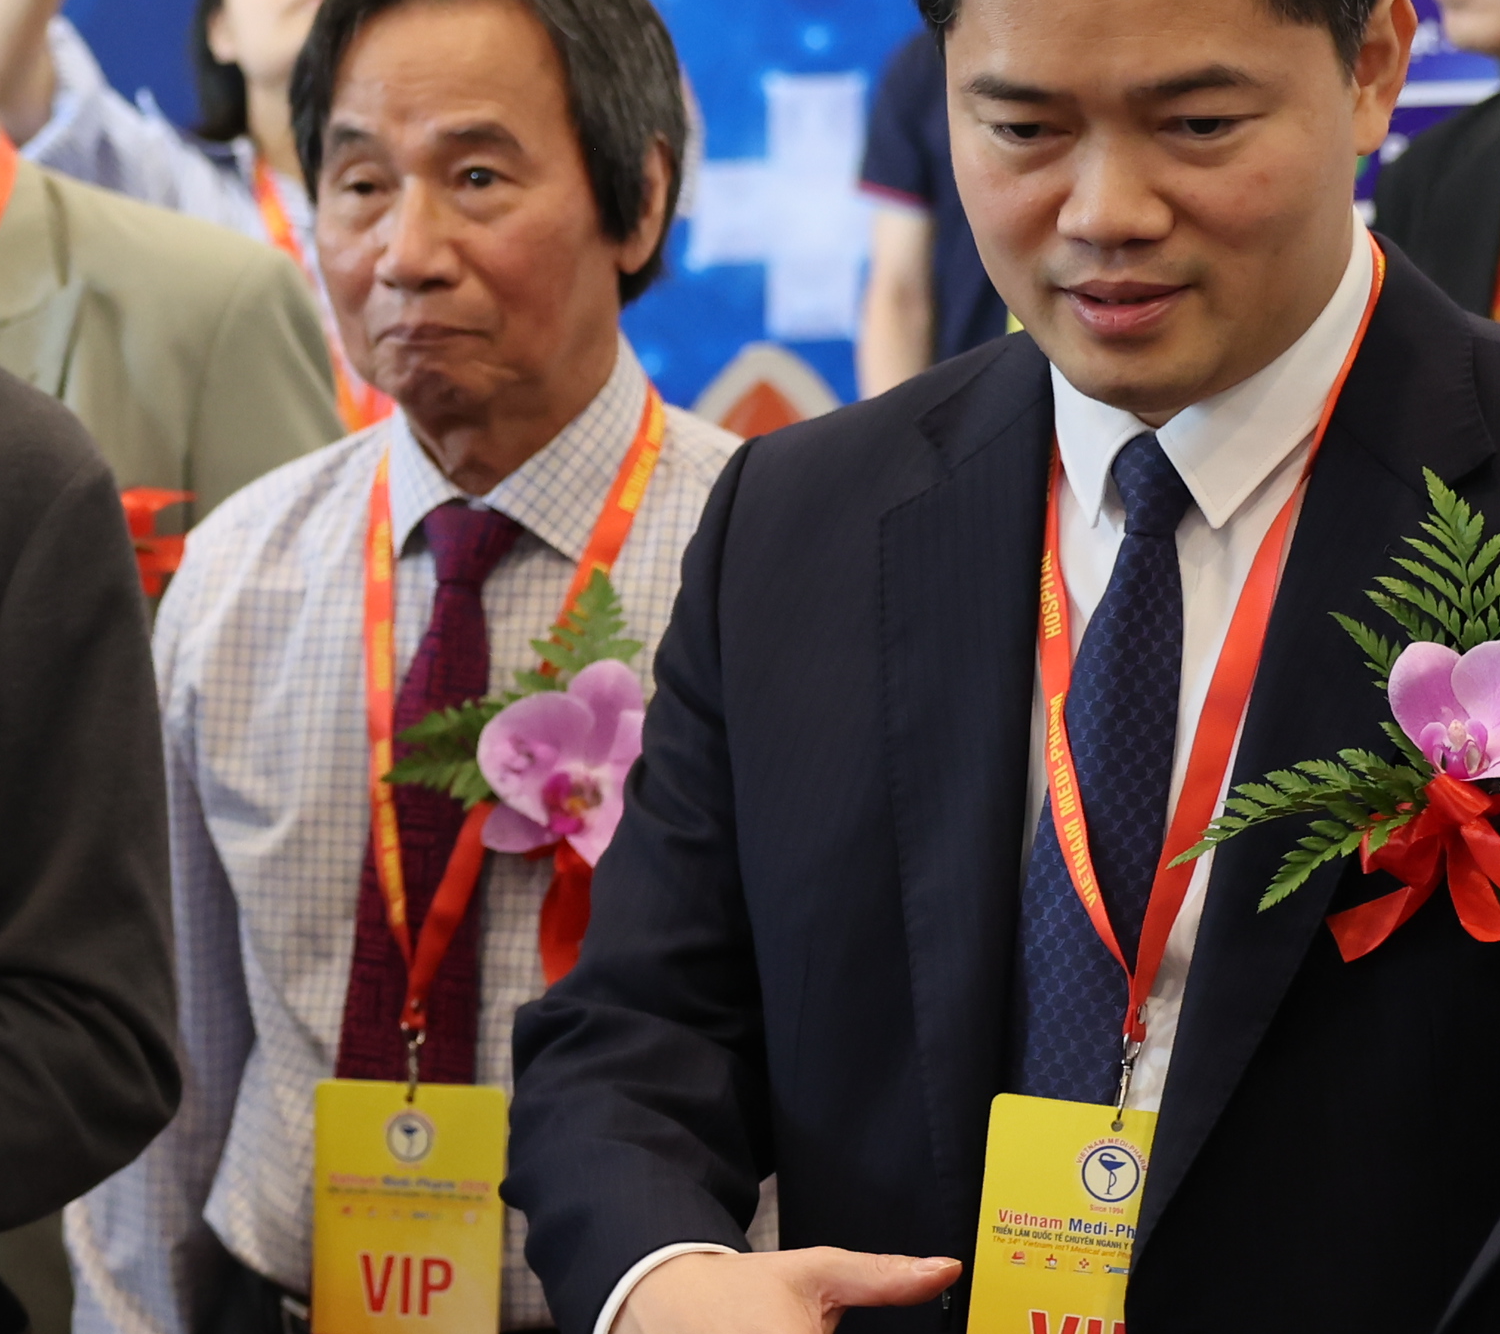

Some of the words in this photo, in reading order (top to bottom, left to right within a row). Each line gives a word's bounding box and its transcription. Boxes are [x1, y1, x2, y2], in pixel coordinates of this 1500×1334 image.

[1040, 548, 1062, 641] HOSPITAL
[1048, 691, 1078, 818] MEDI-PHARM
[1064, 818, 1098, 908] VIETNAM
[1076, 1138, 1106, 1165] VIETNAM
[1107, 1137, 1148, 1172] MEDI-PHARM
[998, 1209, 1063, 1230] Vietnam
[1068, 1218, 1138, 1241] Medi-Ph
[359, 1253, 455, 1316] VIP
